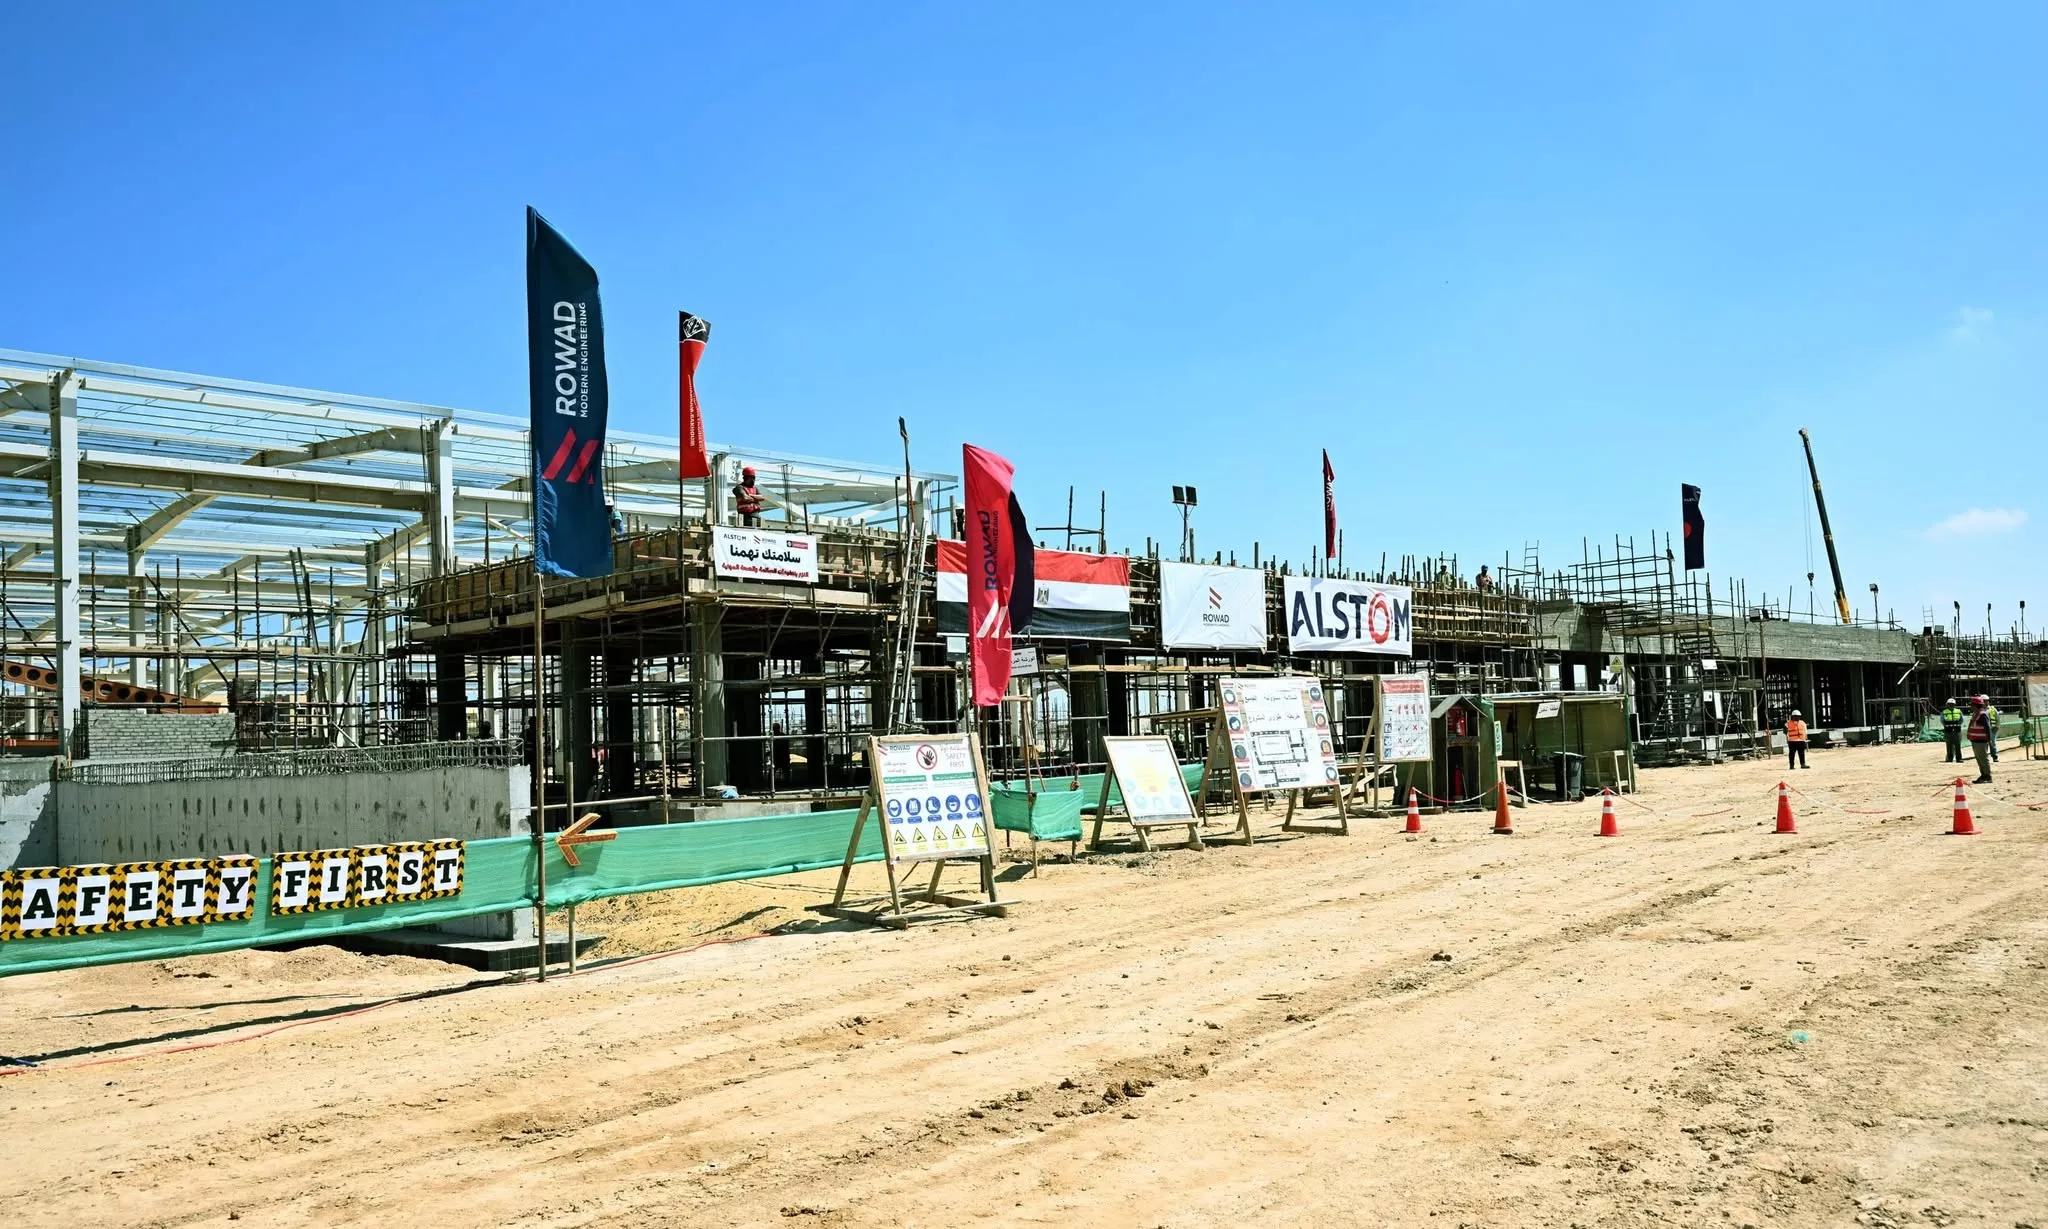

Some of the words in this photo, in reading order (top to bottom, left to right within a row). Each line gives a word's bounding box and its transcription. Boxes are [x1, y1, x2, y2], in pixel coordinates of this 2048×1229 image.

[578, 302, 588, 372] ENGINEERING
[554, 301, 577, 416] ROWAD
[580, 374, 588, 418] MODERN
[723, 533, 747, 541] ALSTOM
[730, 544, 759, 561] تهمنا
[762, 549, 801, 564] سلامتك
[978, 510, 999, 591] ROWAD
[1202, 613, 1230, 623] ROWAD
[1291, 590, 1410, 646] ALSTOM
[284, 858, 457, 897] FIRST
